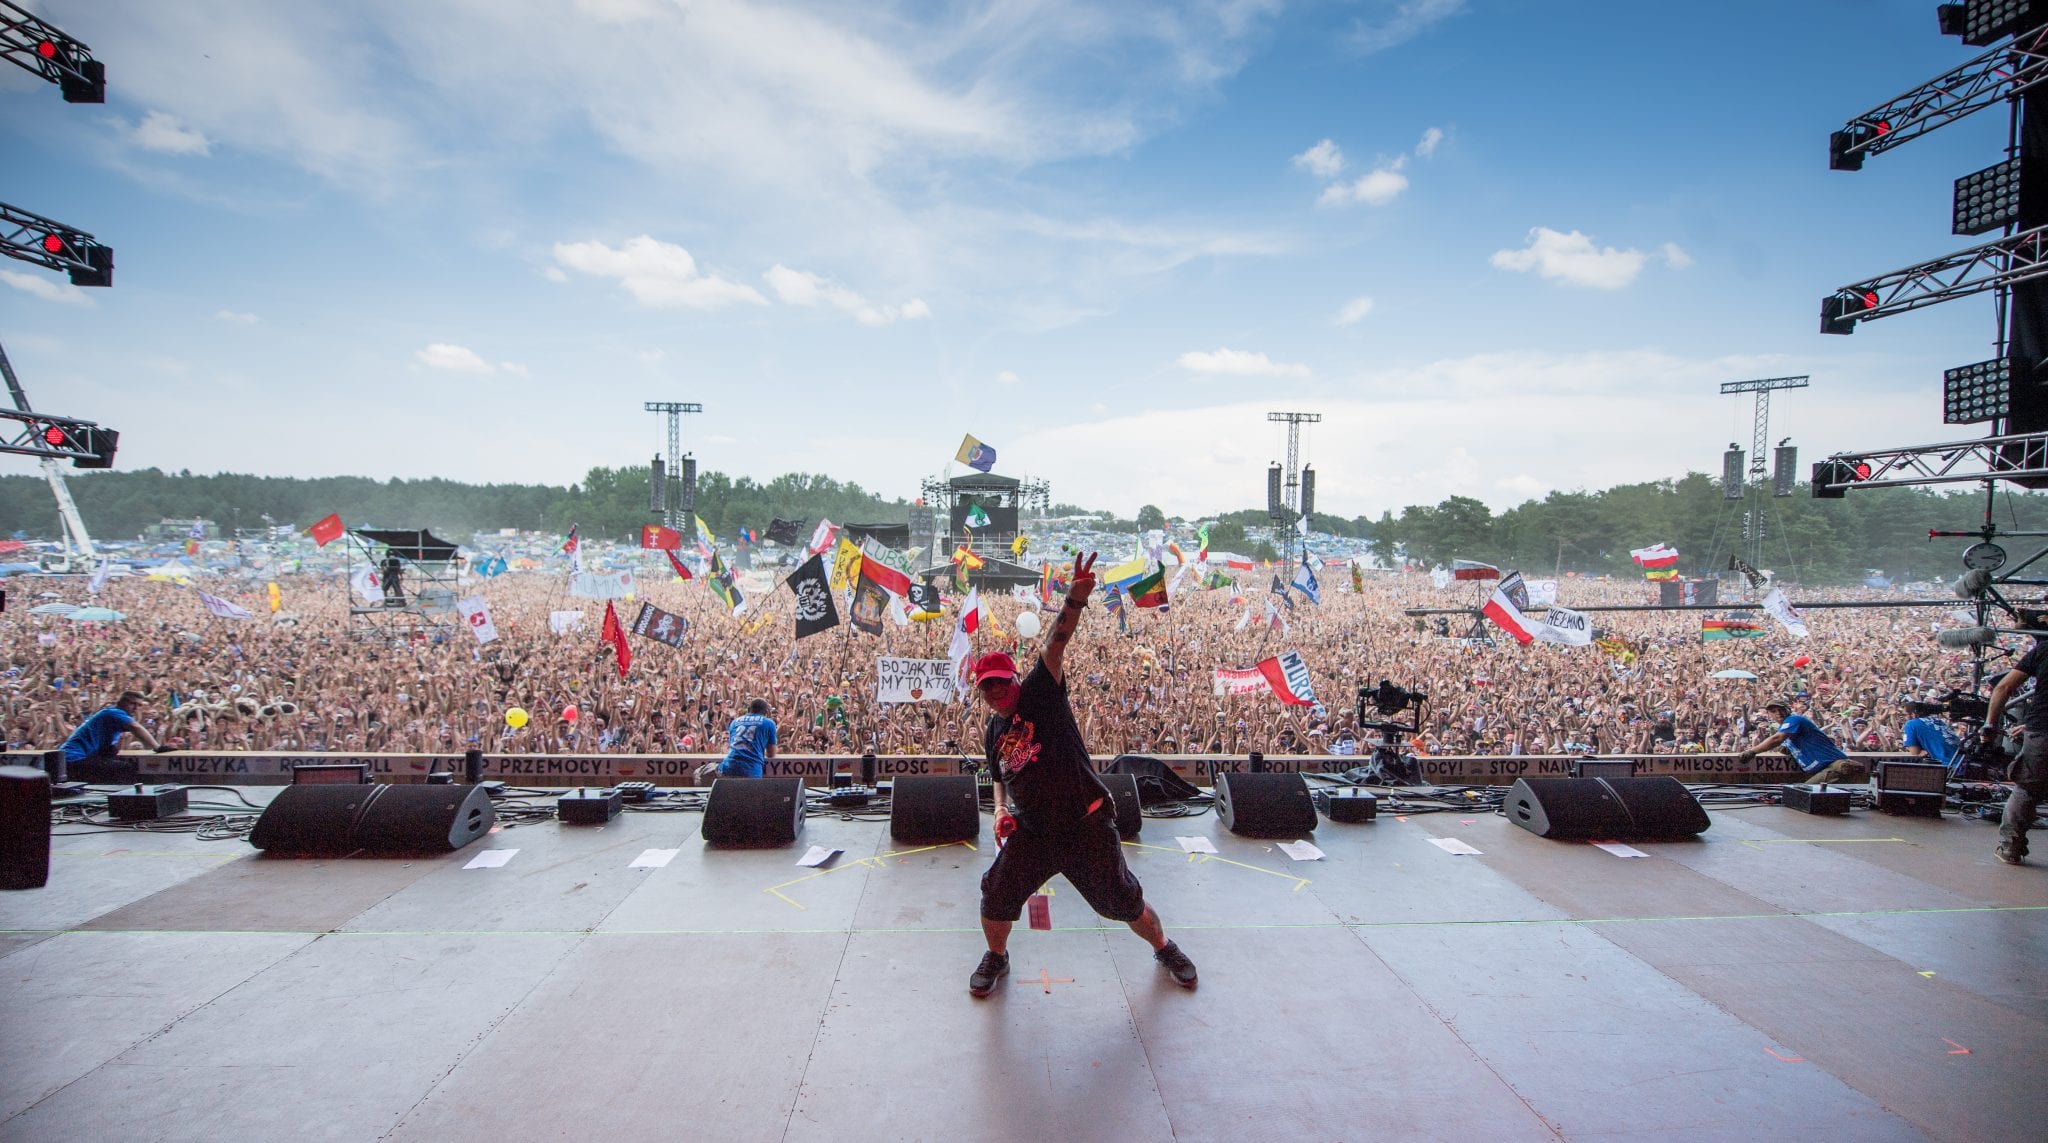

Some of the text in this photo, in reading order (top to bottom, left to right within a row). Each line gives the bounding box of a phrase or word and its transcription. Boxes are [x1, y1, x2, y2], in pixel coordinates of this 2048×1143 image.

[864, 537, 916, 576] LUBSKO
[881, 660, 951, 677] BO JAK NIE
[881, 674, 904, 690] MY
[905, 676, 922, 690] TO
[168, 758, 249, 773] MUZYKA
[447, 758, 611, 775] STP PRZEMOCY!
[645, 759, 689, 775] STOP
[1490, 760, 1529, 775] STOP
